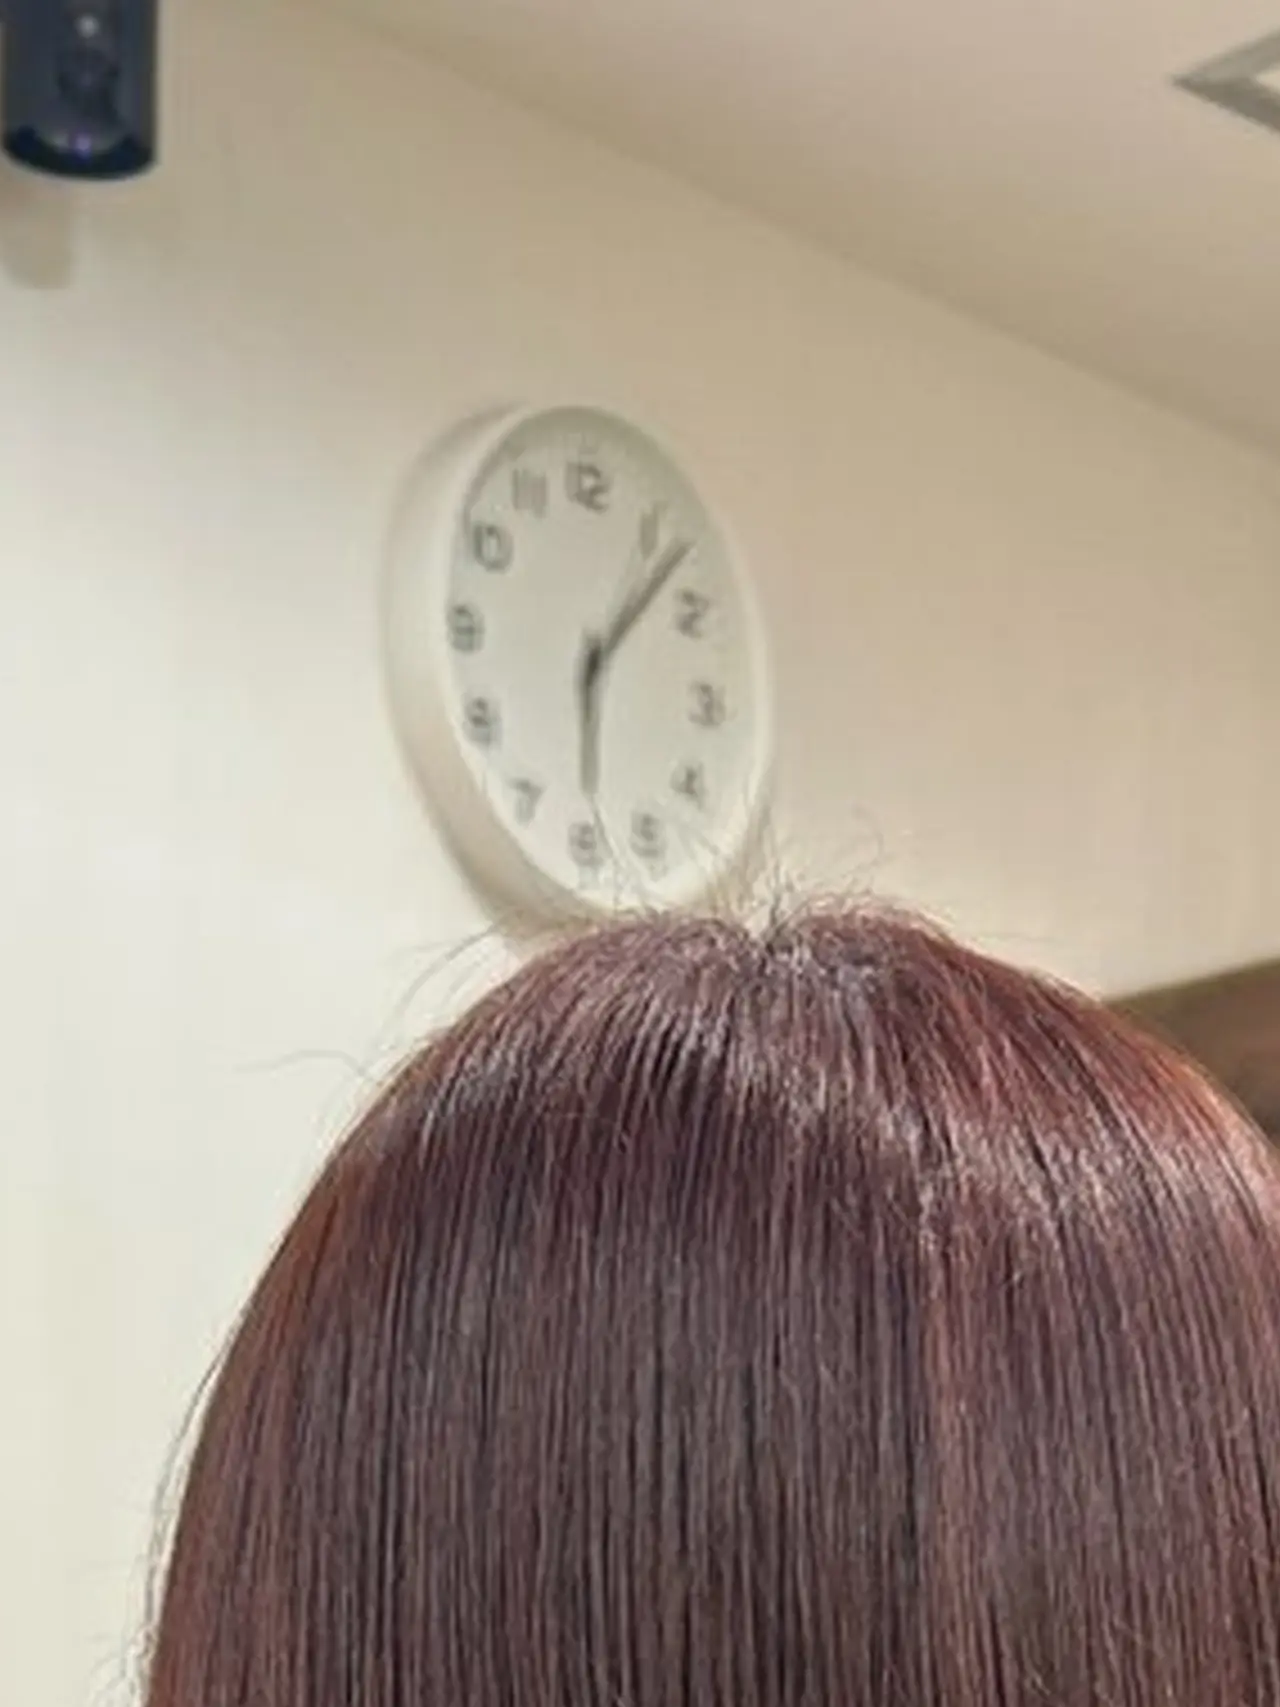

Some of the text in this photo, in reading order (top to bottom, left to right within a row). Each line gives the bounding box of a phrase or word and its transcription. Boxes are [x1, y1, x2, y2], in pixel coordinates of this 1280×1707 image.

[675, 588, 711, 640] 2
[686, 680, 726, 729] 3
[511, 776, 545, 826] 7
